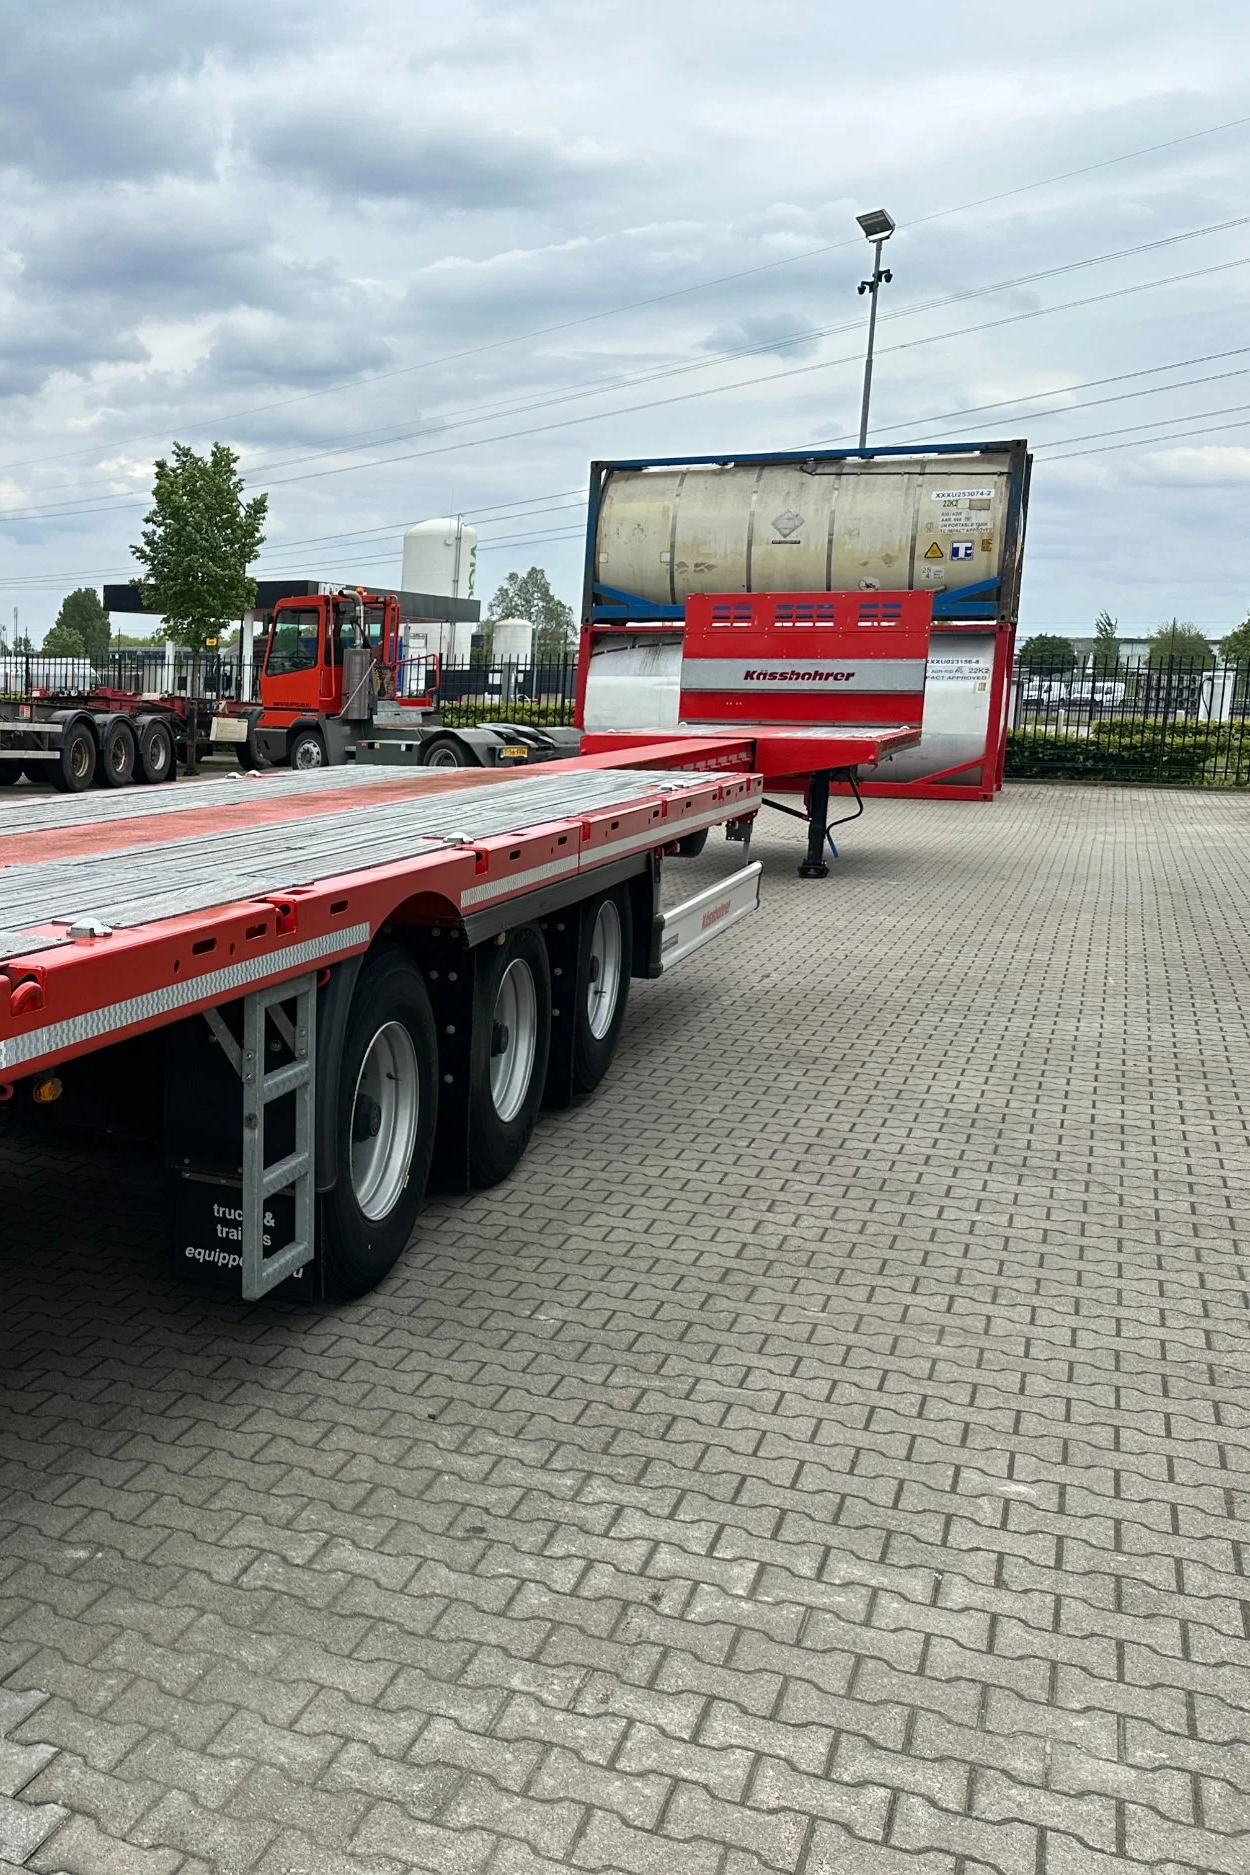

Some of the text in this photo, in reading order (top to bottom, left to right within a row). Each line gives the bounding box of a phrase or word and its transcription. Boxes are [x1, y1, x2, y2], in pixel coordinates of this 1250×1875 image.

[743, 670, 855, 681] Kässbohrer
[213, 1203, 275, 1227] truc &
[216, 1223, 272, 1246] trais
